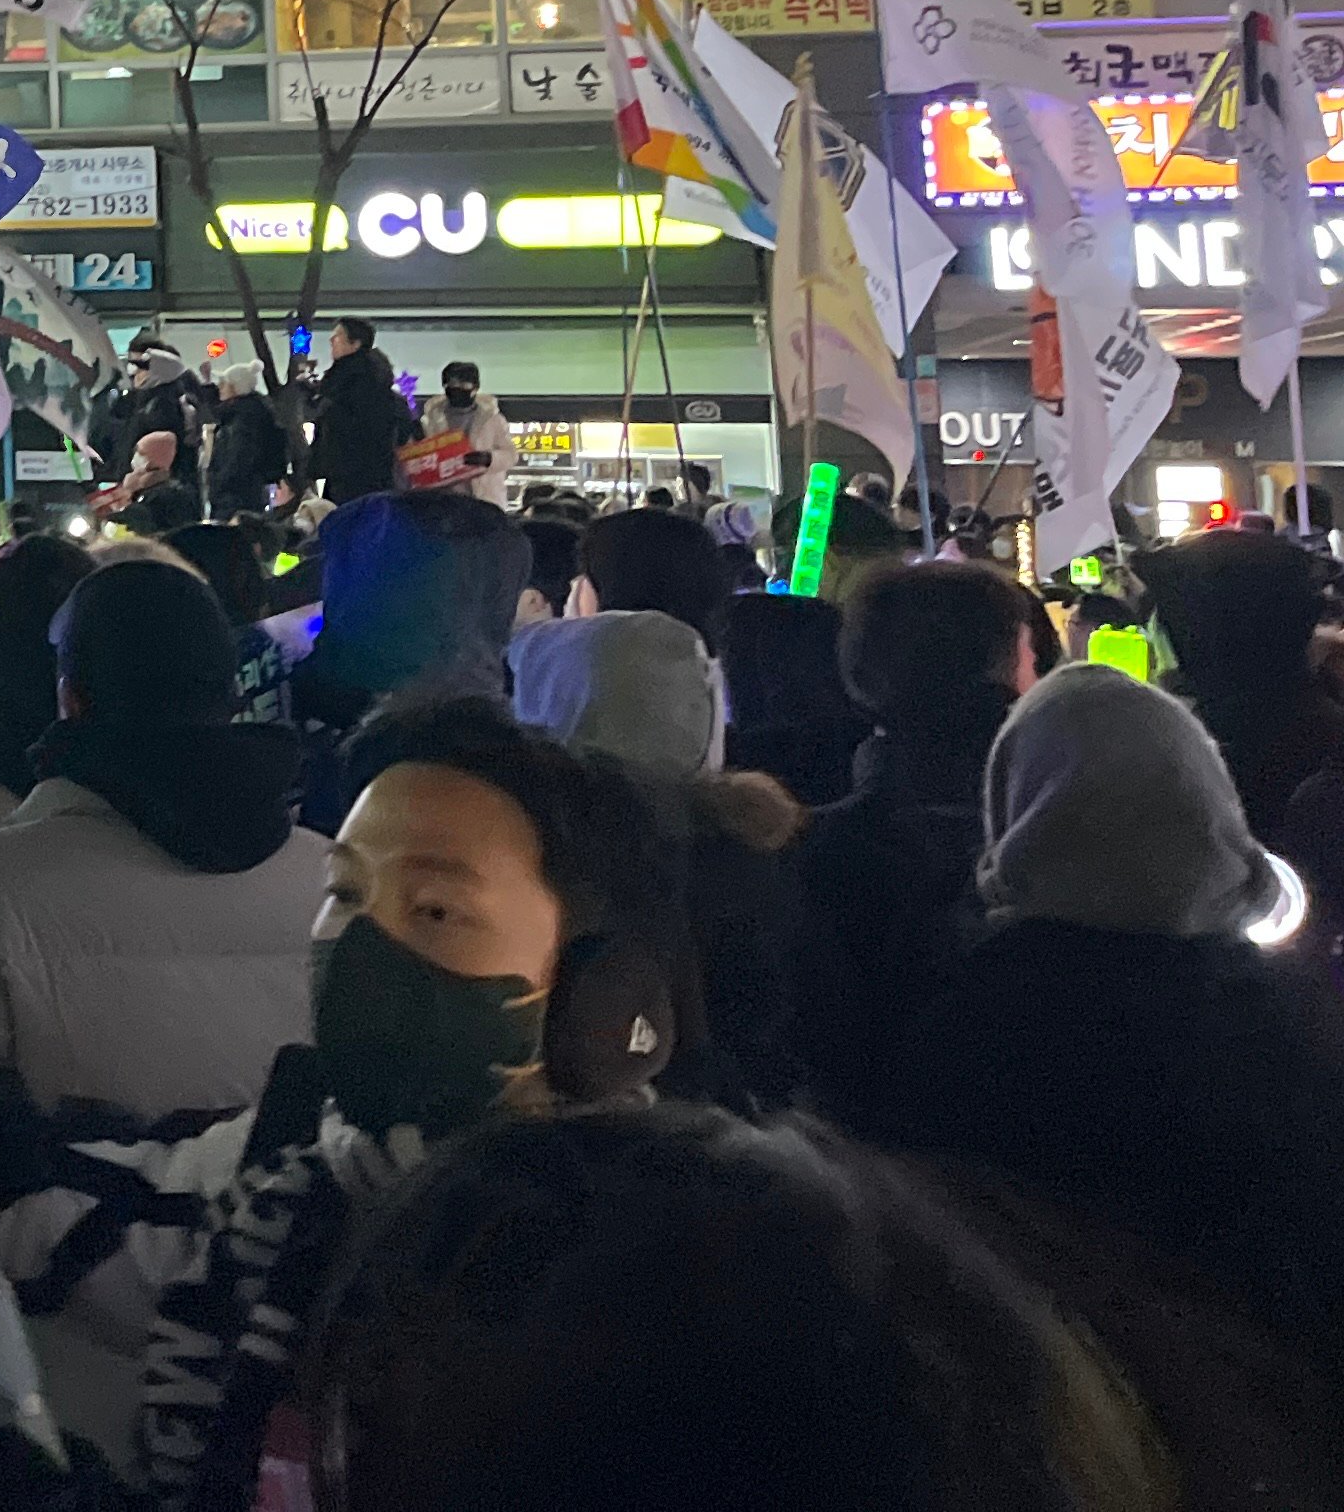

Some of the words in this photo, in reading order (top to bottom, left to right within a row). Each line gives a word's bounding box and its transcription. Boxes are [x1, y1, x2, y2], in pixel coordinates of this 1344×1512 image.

[575, 62, 603, 101] 술
[27, 194, 149, 217] 782-1933
[230, 218, 288, 238] Nice
[357, 191, 488, 258] CU
[85, 253, 142, 287] 24
[939, 411, 1026, 447] OUT
